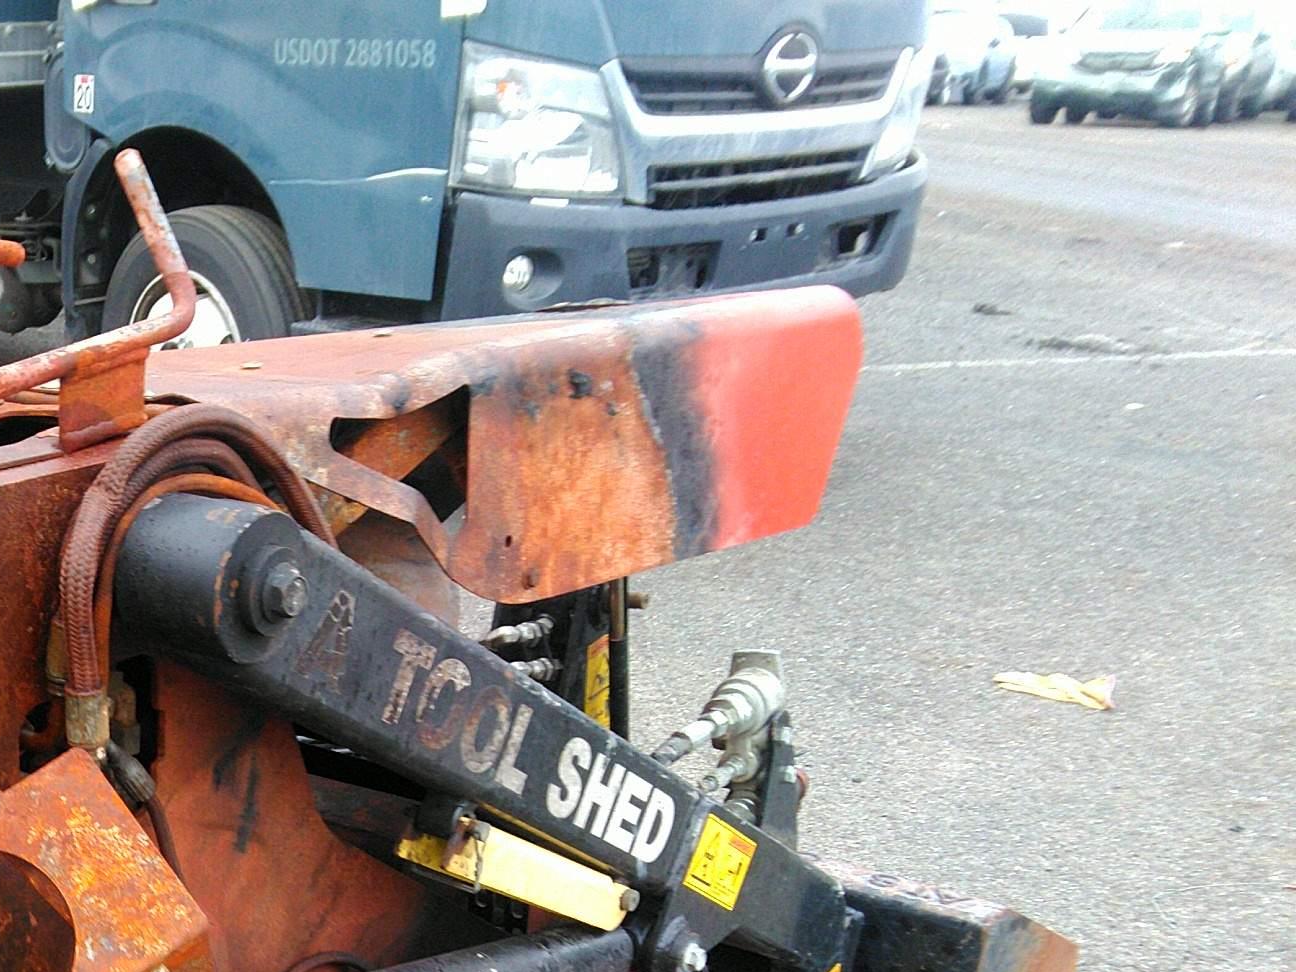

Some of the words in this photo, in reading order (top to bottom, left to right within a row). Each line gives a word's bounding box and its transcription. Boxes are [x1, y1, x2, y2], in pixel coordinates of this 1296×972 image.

[274, 37, 341, 66] USDOT
[344, 38, 437, 69] 2881058
[76, 84, 92, 110] 20
[381, 628, 534, 798] TOOL
[546, 736, 675, 865] SHED
